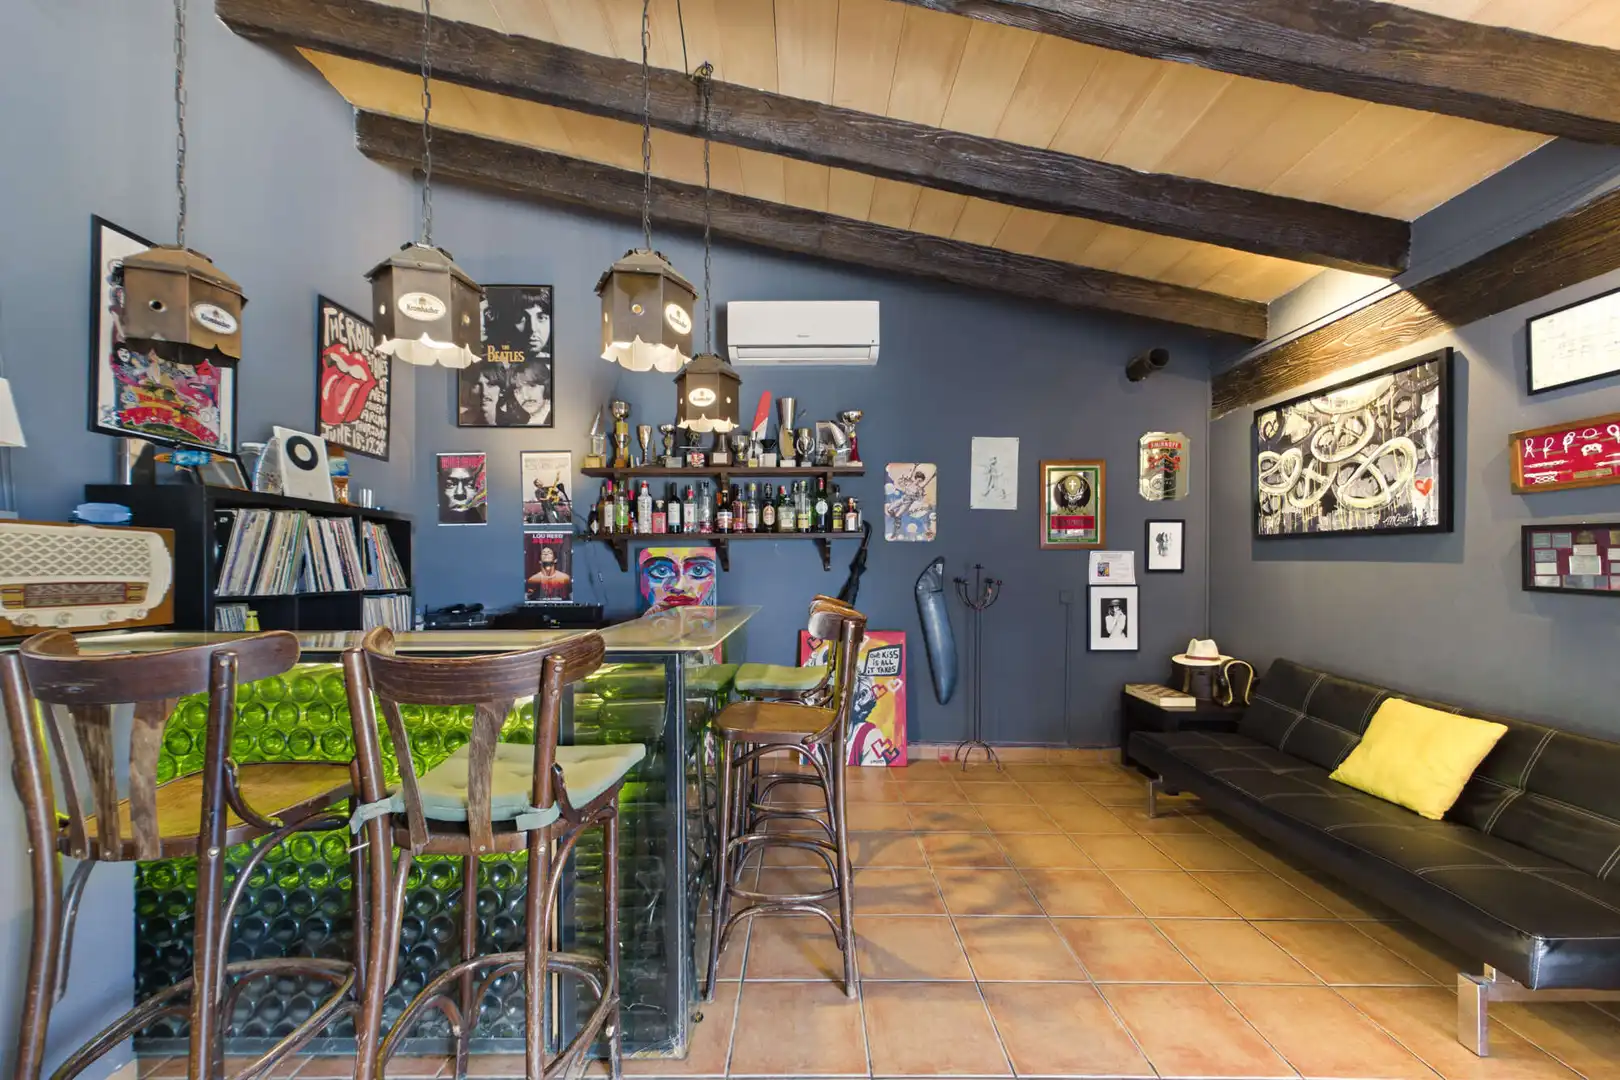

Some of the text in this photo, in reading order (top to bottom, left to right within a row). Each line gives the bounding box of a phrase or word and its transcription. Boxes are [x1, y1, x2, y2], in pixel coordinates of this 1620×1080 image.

[323, 306, 348, 348] THE
[487, 344, 525, 363] BEATLES
[320, 422, 352, 447] JUNE
[876, 665, 896, 673] TAKES
